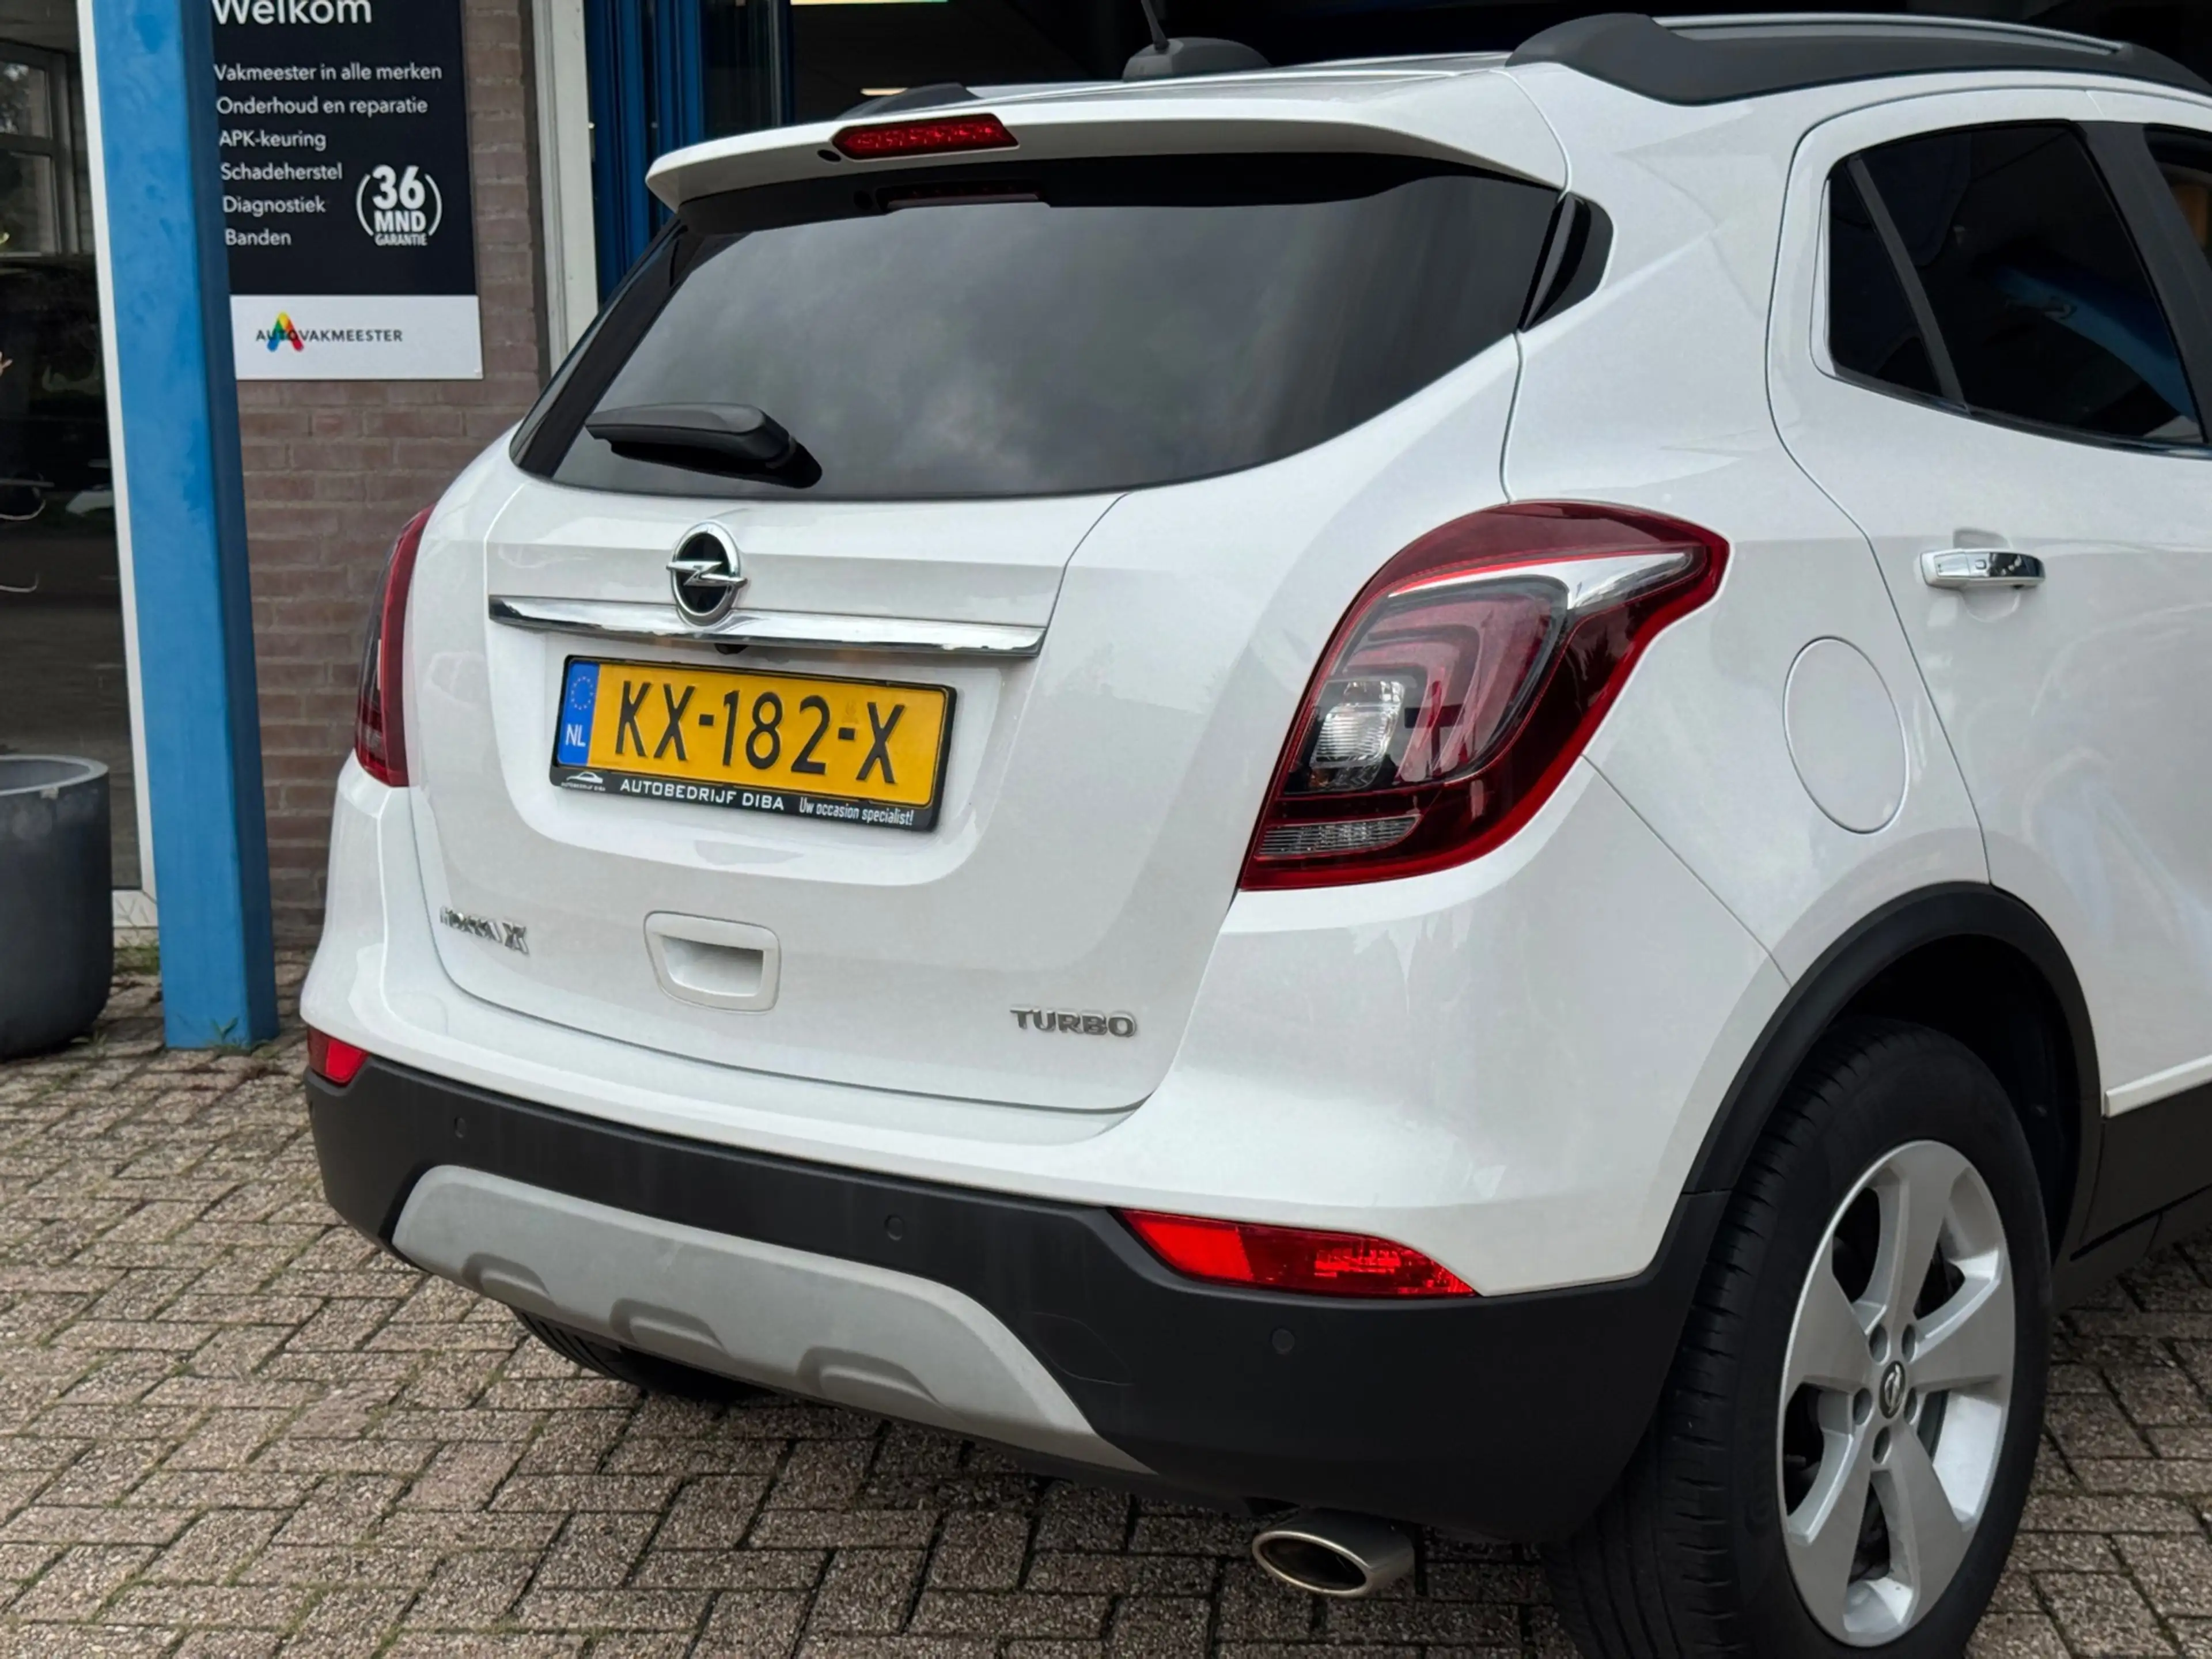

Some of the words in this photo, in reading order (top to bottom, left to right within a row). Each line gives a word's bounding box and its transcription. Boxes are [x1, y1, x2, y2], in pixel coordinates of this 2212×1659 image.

[211, 0, 372, 25] Welkom
[214, 63, 317, 81] Vakmeester
[320, 63, 336, 80] in
[341, 62, 372, 80] alle
[376, 62, 442, 79] merken
[216, 96, 319, 115] Onderhoud
[323, 103, 345, 113] en
[349, 96, 428, 117] reparatie
[219, 130, 327, 151] APK-keuring
[221, 163, 343, 180] Schadeherstel
[372, 165, 425, 210] 36
[223, 196, 326, 217] Diagnostiek
[374, 211, 426, 232] MND
[225, 229, 291, 246] Banden
[374, 233, 428, 246] GARANTIE
[256, 329, 403, 342] AUTOVAKMEESTER
[565, 724, 586, 747] NL
[616, 680, 905, 784] KX-182-X
[620, 779, 737, 805] AUTOBEDRIJF
[741, 793, 785, 811] DIBA
[799, 797, 813, 814] Uw
[816, 803, 859, 819] occasion
[861, 808, 914, 826] specialist!
[1009, 1007, 1137, 1037] TURBO
